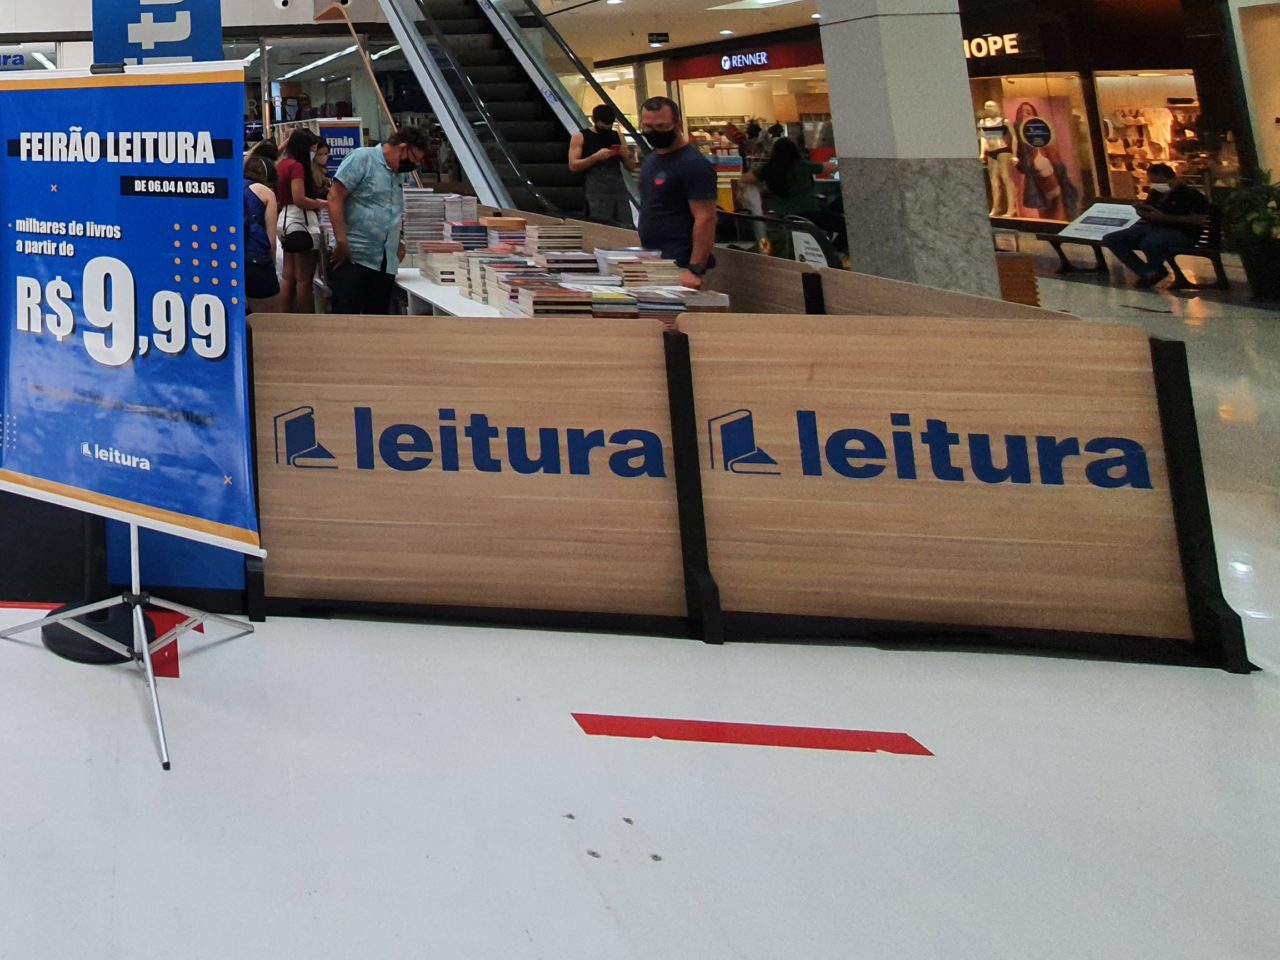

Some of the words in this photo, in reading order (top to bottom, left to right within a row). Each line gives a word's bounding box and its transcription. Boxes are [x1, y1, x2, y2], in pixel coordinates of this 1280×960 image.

[731, 51, 768, 67] RENNER
[20, 126, 101, 163] FEIRÃO
[107, 131, 215, 164] LEITURA
[134, 180, 147, 192] DE
[148, 180, 176, 193] 06.04
[177, 181, 184, 193] A
[185, 181, 215, 194] 03.05
[16, 218, 67, 235] milhares
[68, 221, 84, 236] de
[86, 222, 122, 239] livros
[16, 240, 24, 252] a
[25, 240, 57, 255] partir
[59, 241, 75, 257] de
[354, 407, 667, 478] leitura
[796, 410, 1154, 490] leitura
[94, 443, 151, 471] leitura
